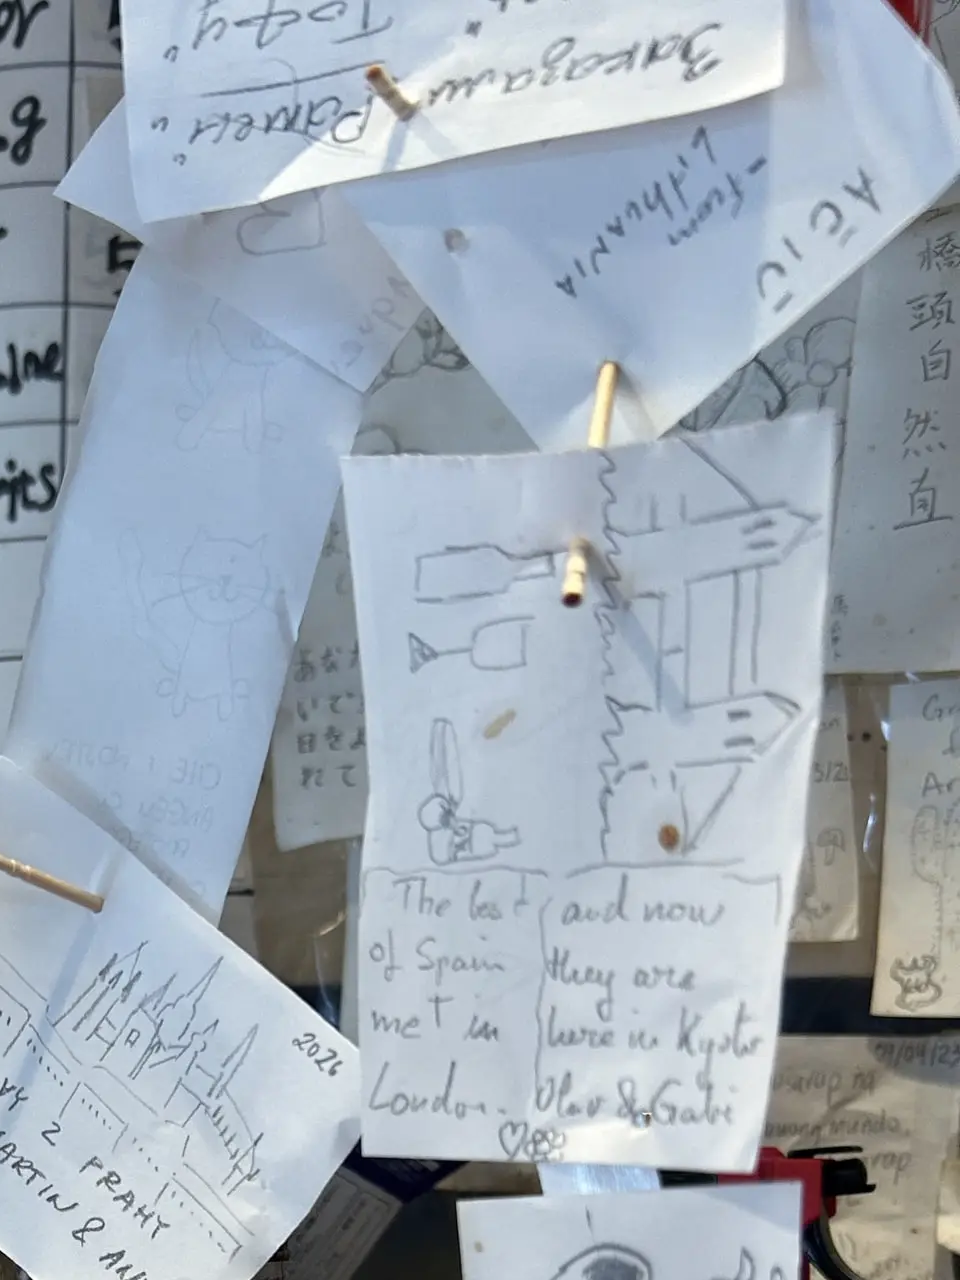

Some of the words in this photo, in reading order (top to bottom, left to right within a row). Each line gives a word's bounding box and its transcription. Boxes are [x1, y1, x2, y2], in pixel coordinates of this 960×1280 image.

[392, 877, 452, 919] The
[560, 872, 629, 927] and
[643, 900, 727, 928] now
[369, 928, 405, 983] of
[415, 935, 506, 983] Spain
[633, 965, 697, 993] are
[371, 995, 455, 1041] met
[463, 1008, 500, 1044] in
[291, 1032, 346, 1079] 2026
[547, 1004, 616, 1050] here
[627, 1008, 659, 1050] in
[675, 1000, 765, 1094] Kyoto
[71, 1217, 106, 1244] &
